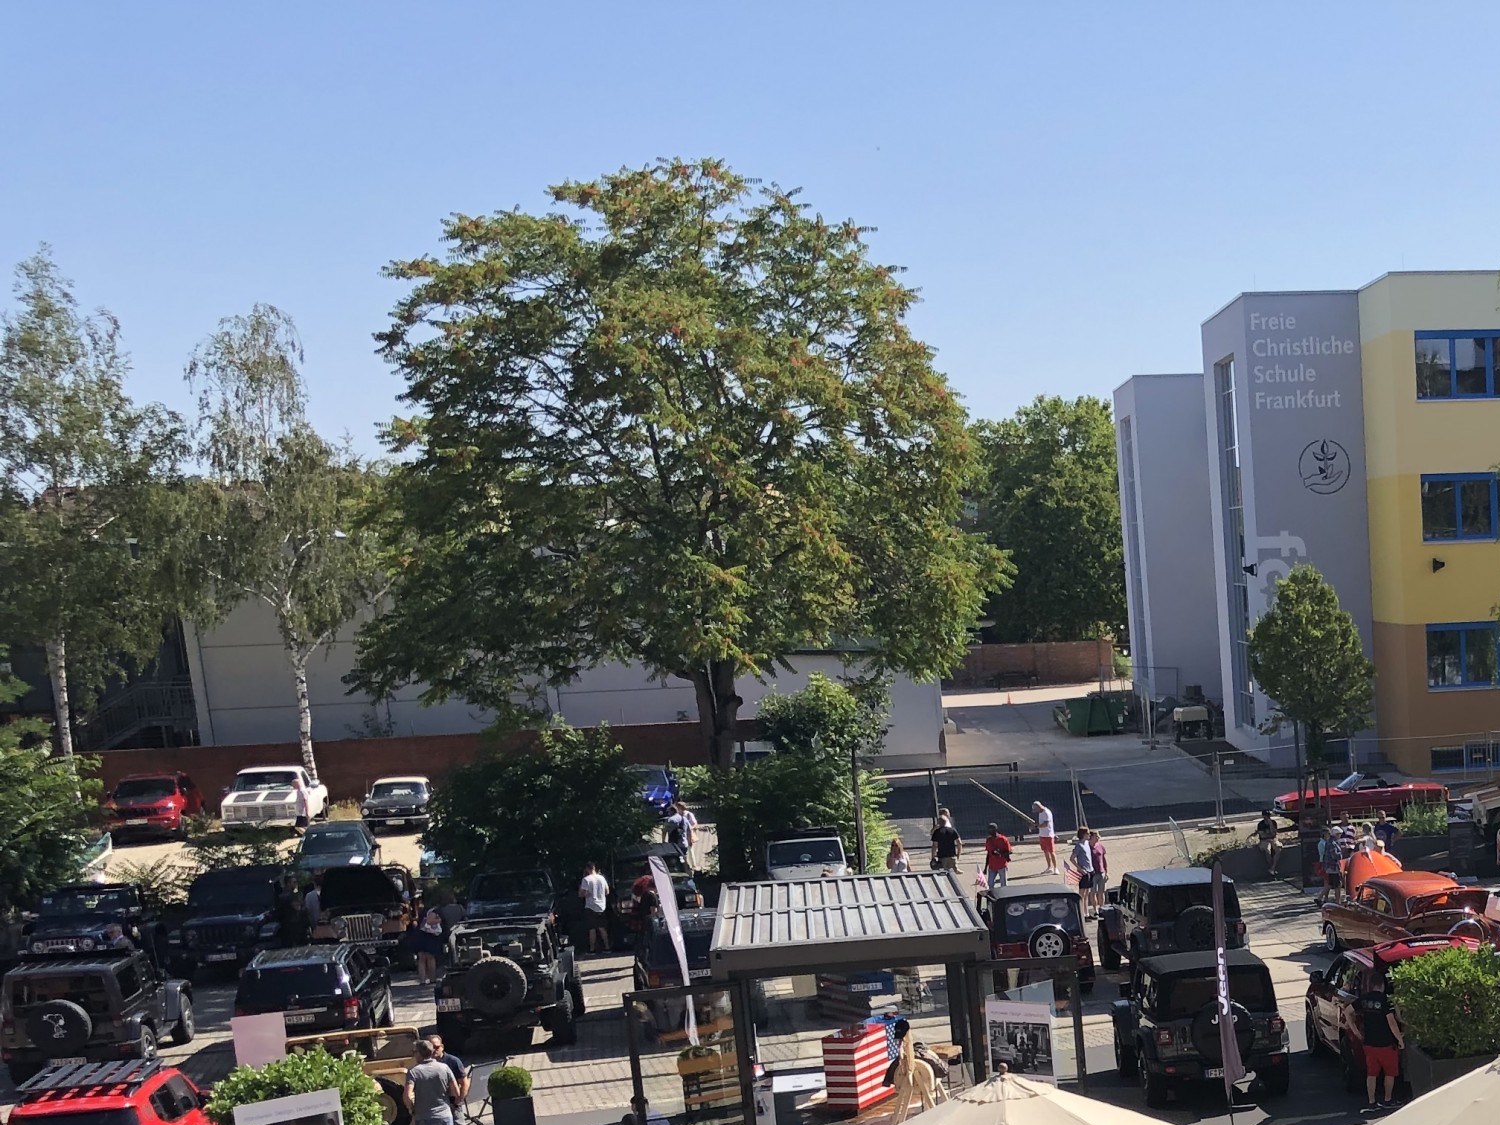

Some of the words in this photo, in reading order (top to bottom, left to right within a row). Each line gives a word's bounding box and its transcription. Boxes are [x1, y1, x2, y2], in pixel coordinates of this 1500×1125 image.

[1250, 313, 1297, 331] Freie
[1252, 335, 1355, 357] Christliche
[1254, 363, 1317, 384] Schule
[1255, 389, 1342, 410] Frankfurt
